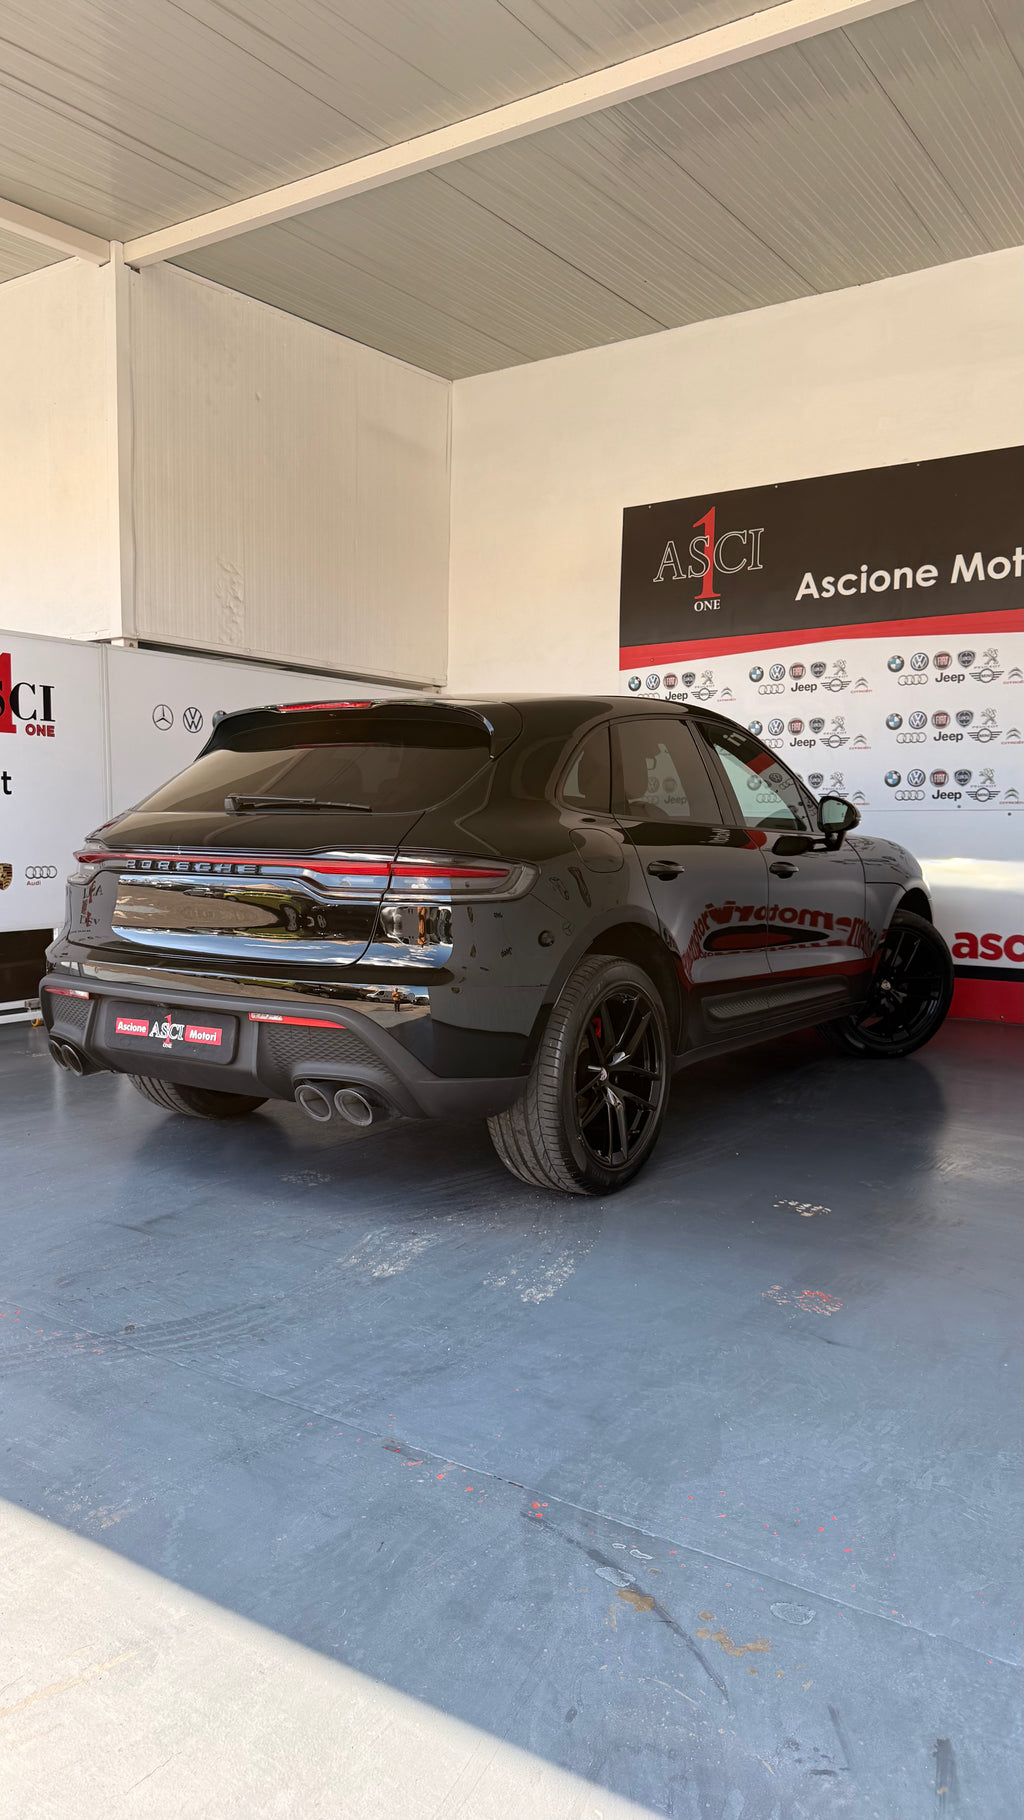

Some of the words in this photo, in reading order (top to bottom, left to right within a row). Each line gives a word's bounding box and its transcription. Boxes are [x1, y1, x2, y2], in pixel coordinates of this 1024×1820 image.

[653, 528, 764, 583] ASCI
[795, 564, 939, 601] Ascione
[950, 547, 1024, 584] Mot
[694, 599, 721, 612] ONE
[935, 672, 965, 684] Jeep
[791, 682, 818, 693] Jeep
[665, 691, 688, 701] Jeep
[25, 723, 56, 738] ONE
[933, 731, 964, 743] Jeep
[790, 737, 816, 749] Jeep
[932, 789, 962, 802] Jeep
[117, 1020, 147, 1034] Ascione
[149, 1020, 185, 1041] ASCI
[189, 1029, 217, 1042] Motori
